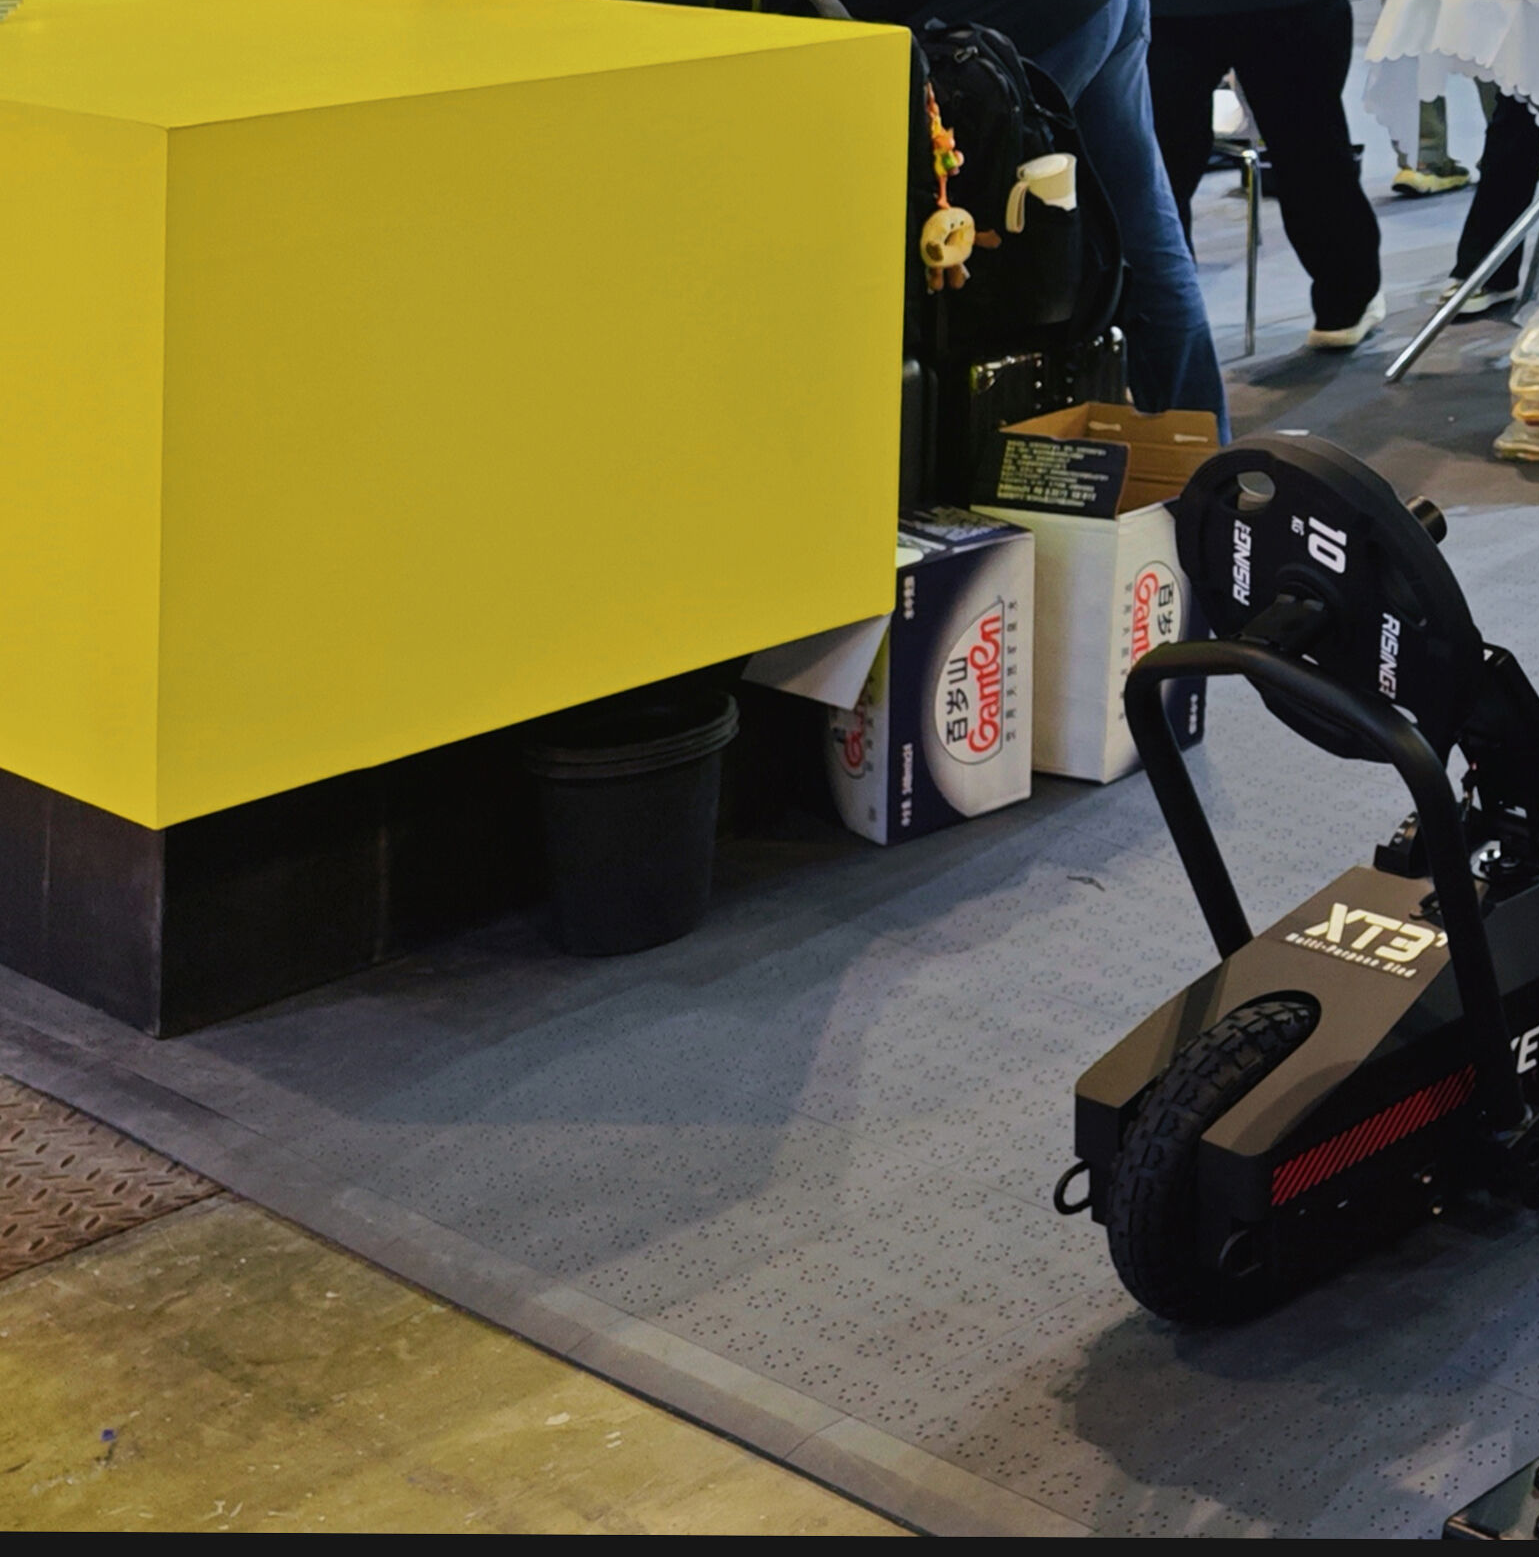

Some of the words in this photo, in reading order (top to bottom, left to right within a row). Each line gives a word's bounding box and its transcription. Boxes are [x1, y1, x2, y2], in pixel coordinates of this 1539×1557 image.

[1232, 519, 1252, 607] RISING
[1307, 516, 1348, 575] 10
[1158, 581, 1175, 643] 百岁
[946, 656, 969, 745] 百岁山
[967, 614, 1002, 753] Ganten
[1379, 612, 1401, 701] RISING
